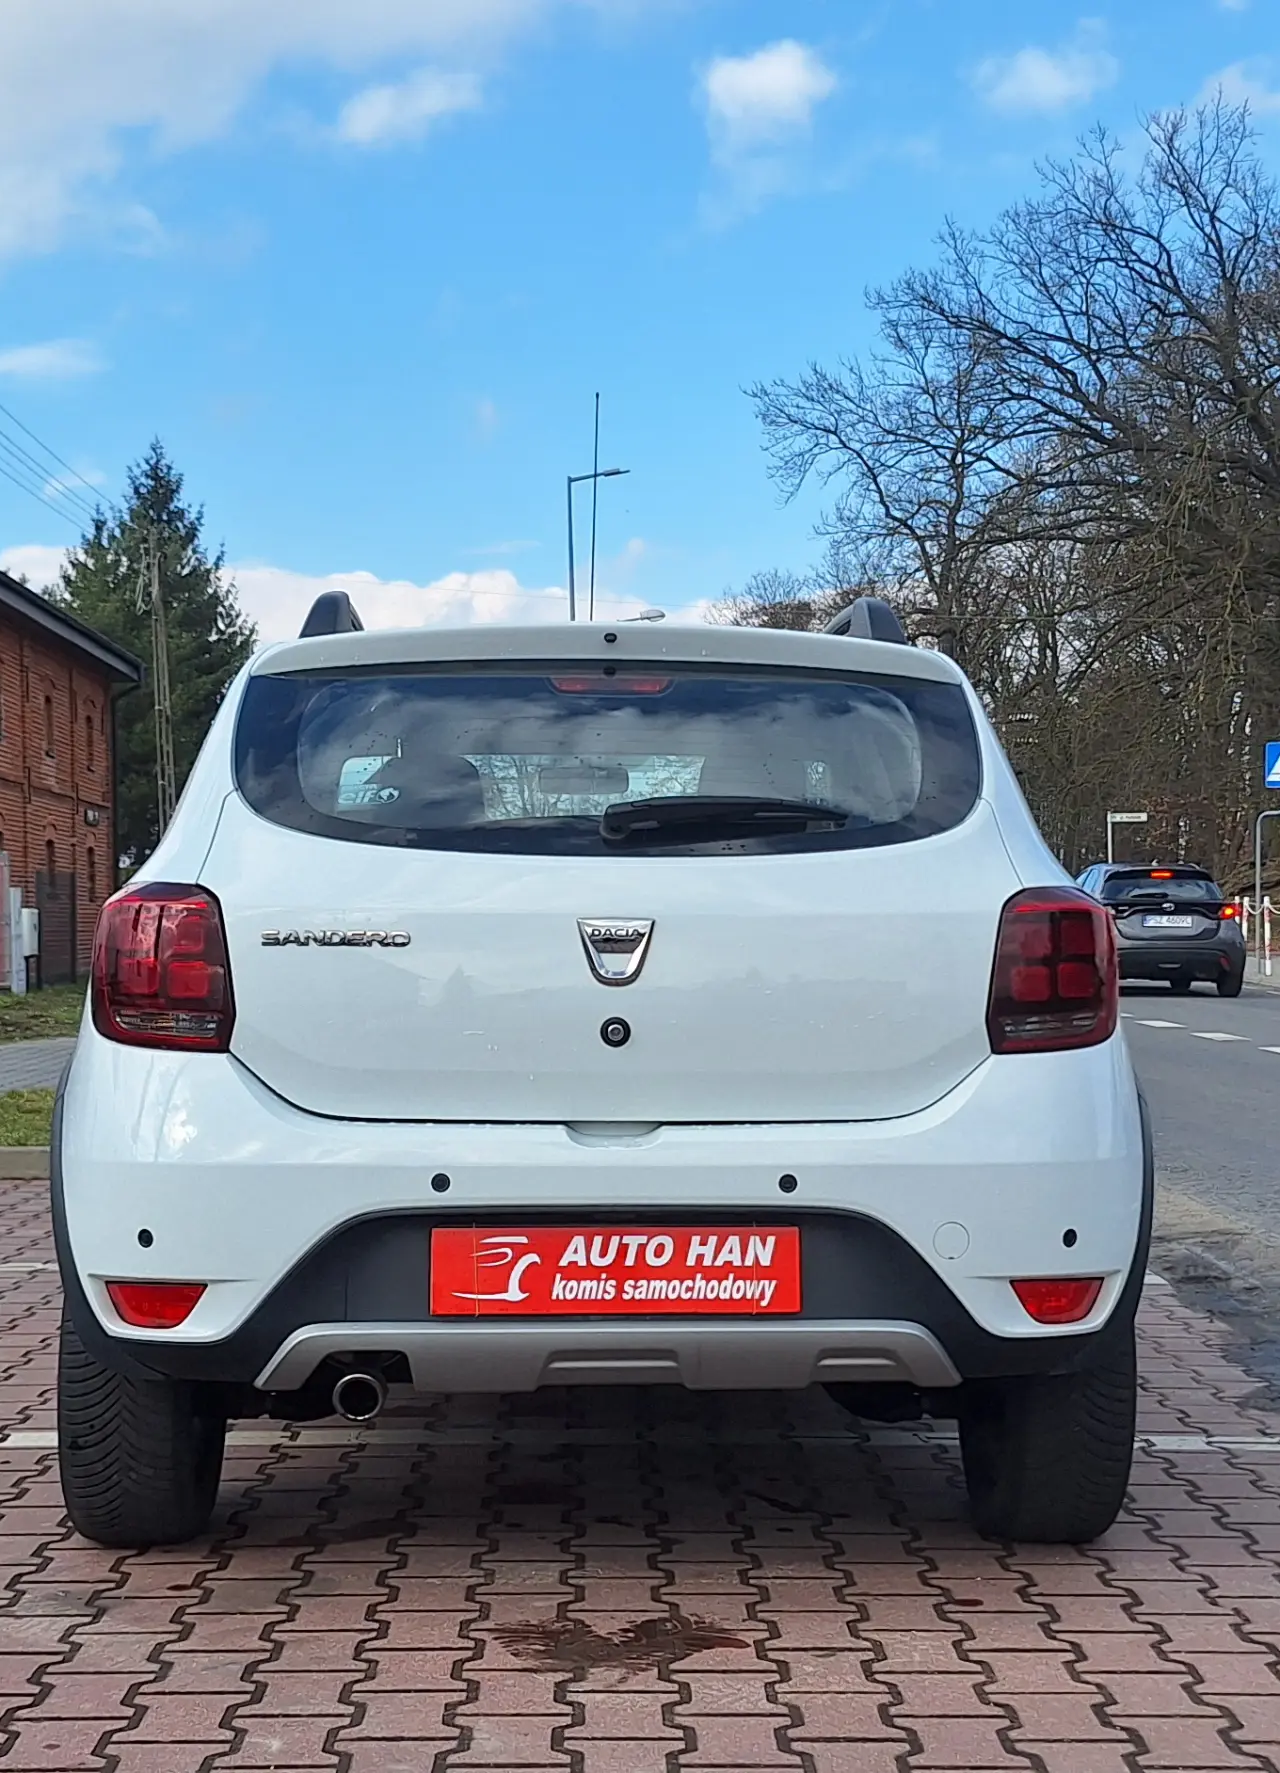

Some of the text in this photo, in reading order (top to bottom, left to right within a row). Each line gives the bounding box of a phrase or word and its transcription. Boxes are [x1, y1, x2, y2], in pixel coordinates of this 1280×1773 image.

[261, 929, 412, 948] SANDERO
[590, 928, 641, 938] DACIA
[558, 1235, 776, 1268] AUTO HAN
[551, 1273, 777, 1307] komis samochodowy
